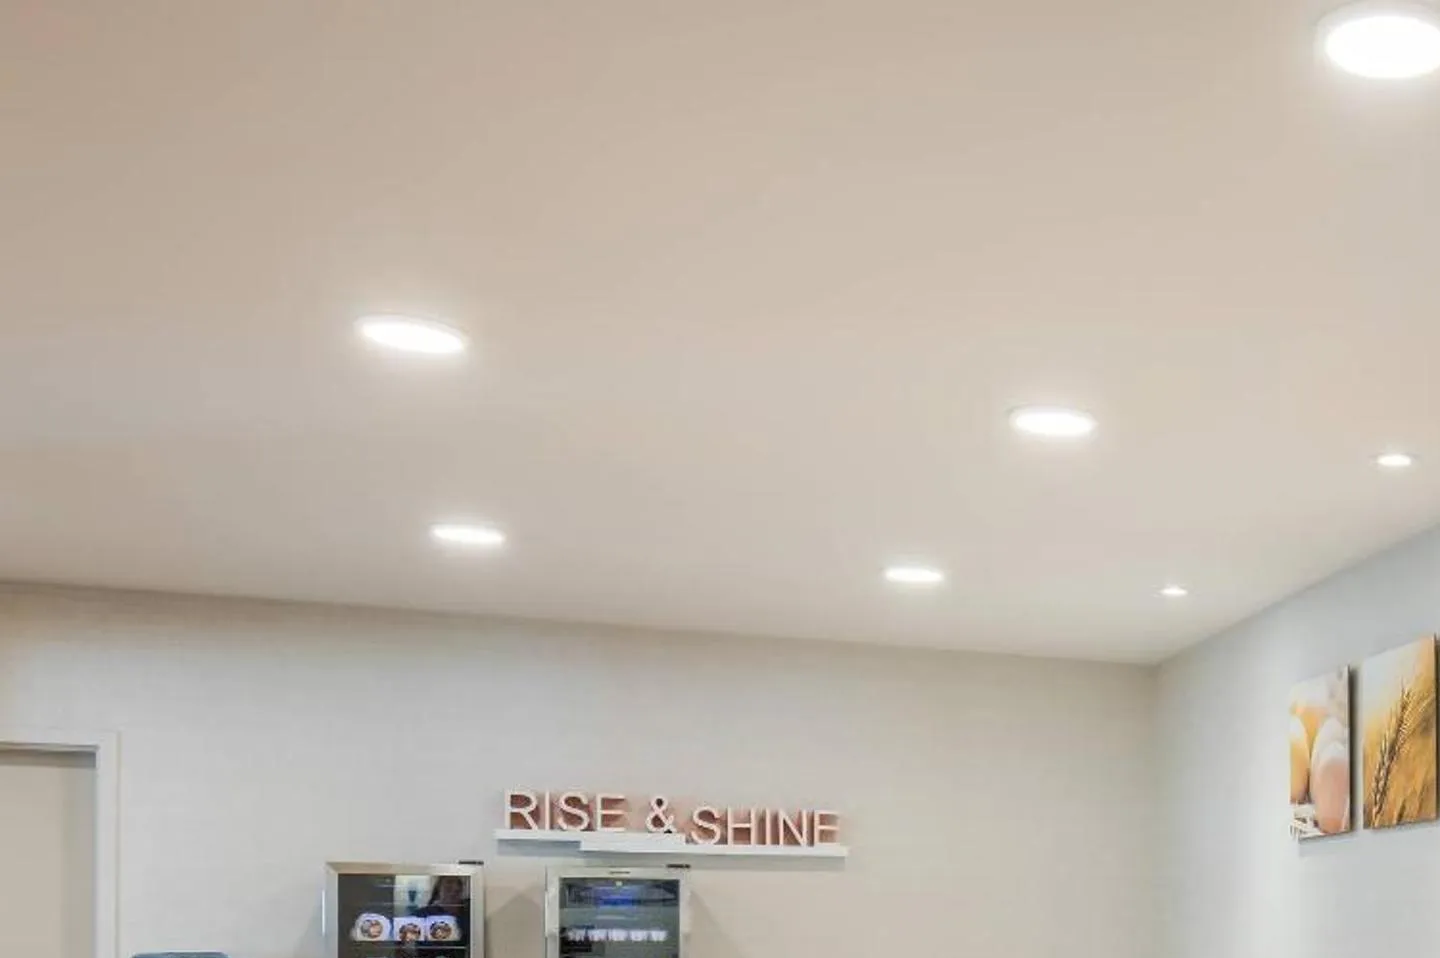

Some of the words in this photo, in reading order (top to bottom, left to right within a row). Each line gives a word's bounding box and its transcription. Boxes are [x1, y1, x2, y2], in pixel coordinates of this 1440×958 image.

[504, 791, 627, 832] RISE
[646, 795, 678, 833] &
[690, 805, 841, 847] SHINE
